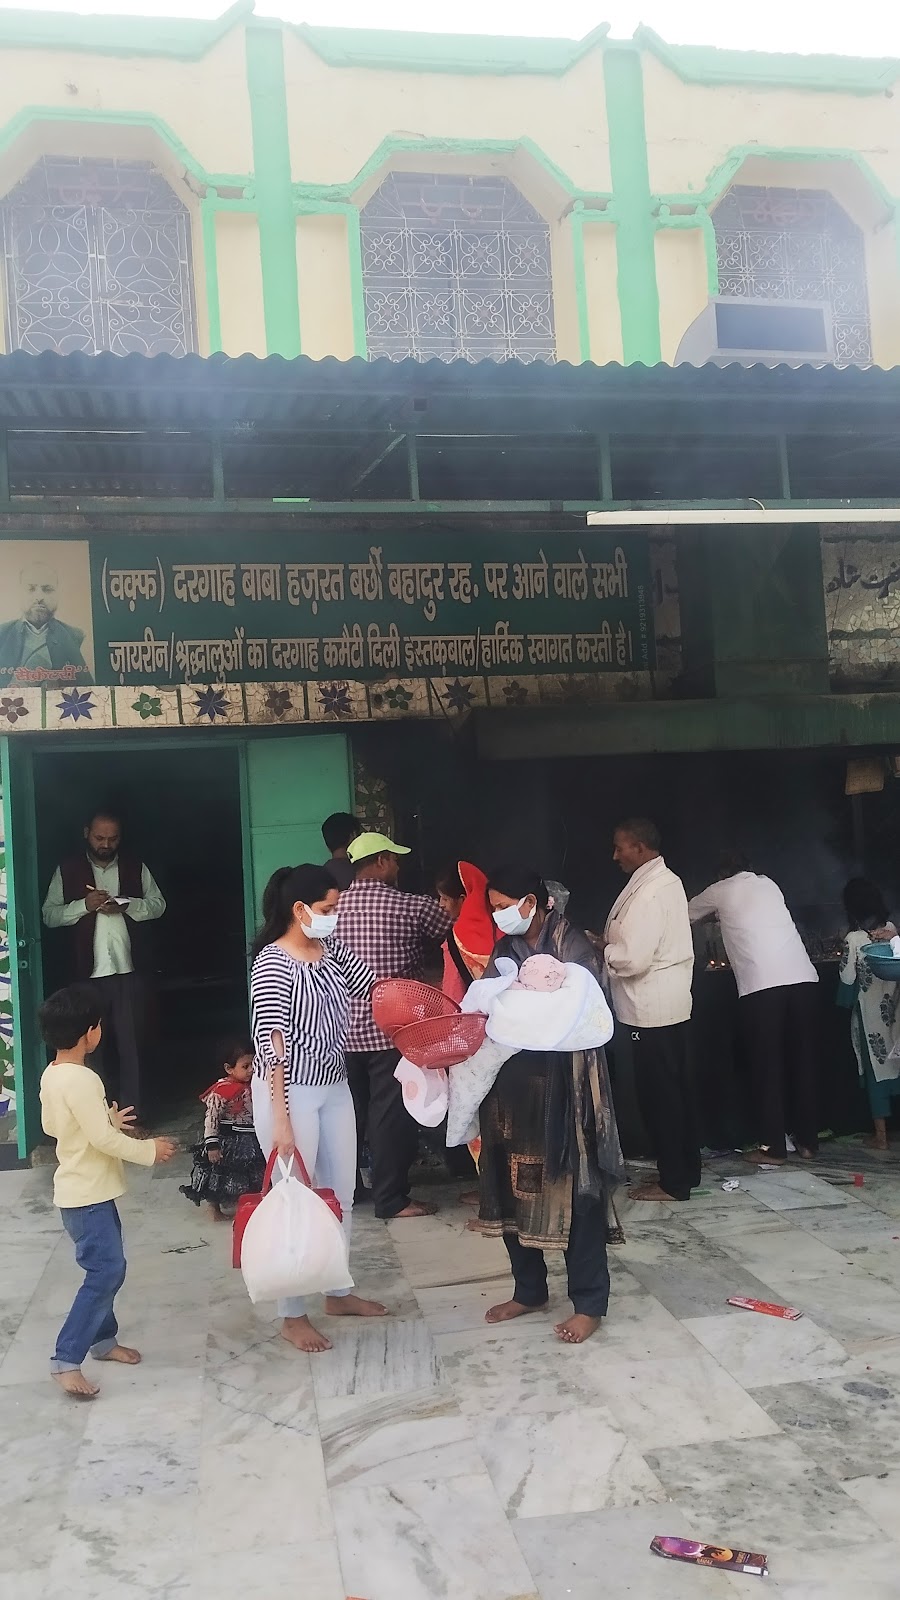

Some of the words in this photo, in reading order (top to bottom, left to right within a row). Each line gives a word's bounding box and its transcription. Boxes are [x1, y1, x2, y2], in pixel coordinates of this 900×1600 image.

[172, 563, 236, 607] दरगाह
[240, 563, 281, 602] बाबा
[285, 563, 345, 615] हज़रत
[387, 562, 445, 622] बहादुर
[447, 562, 479, 604] रह.
[483, 562, 508, 600] पर
[512, 549, 549, 600] आने
[553, 548, 589, 600] वाले
[592, 546, 629, 600] सभी
[247, 638, 268, 669] का
[271, 637, 320, 673] दरगाह
[367, 622, 401, 669] दिली
[527, 633, 573, 665] स्वागत
[575, 619, 612, 663] करती
